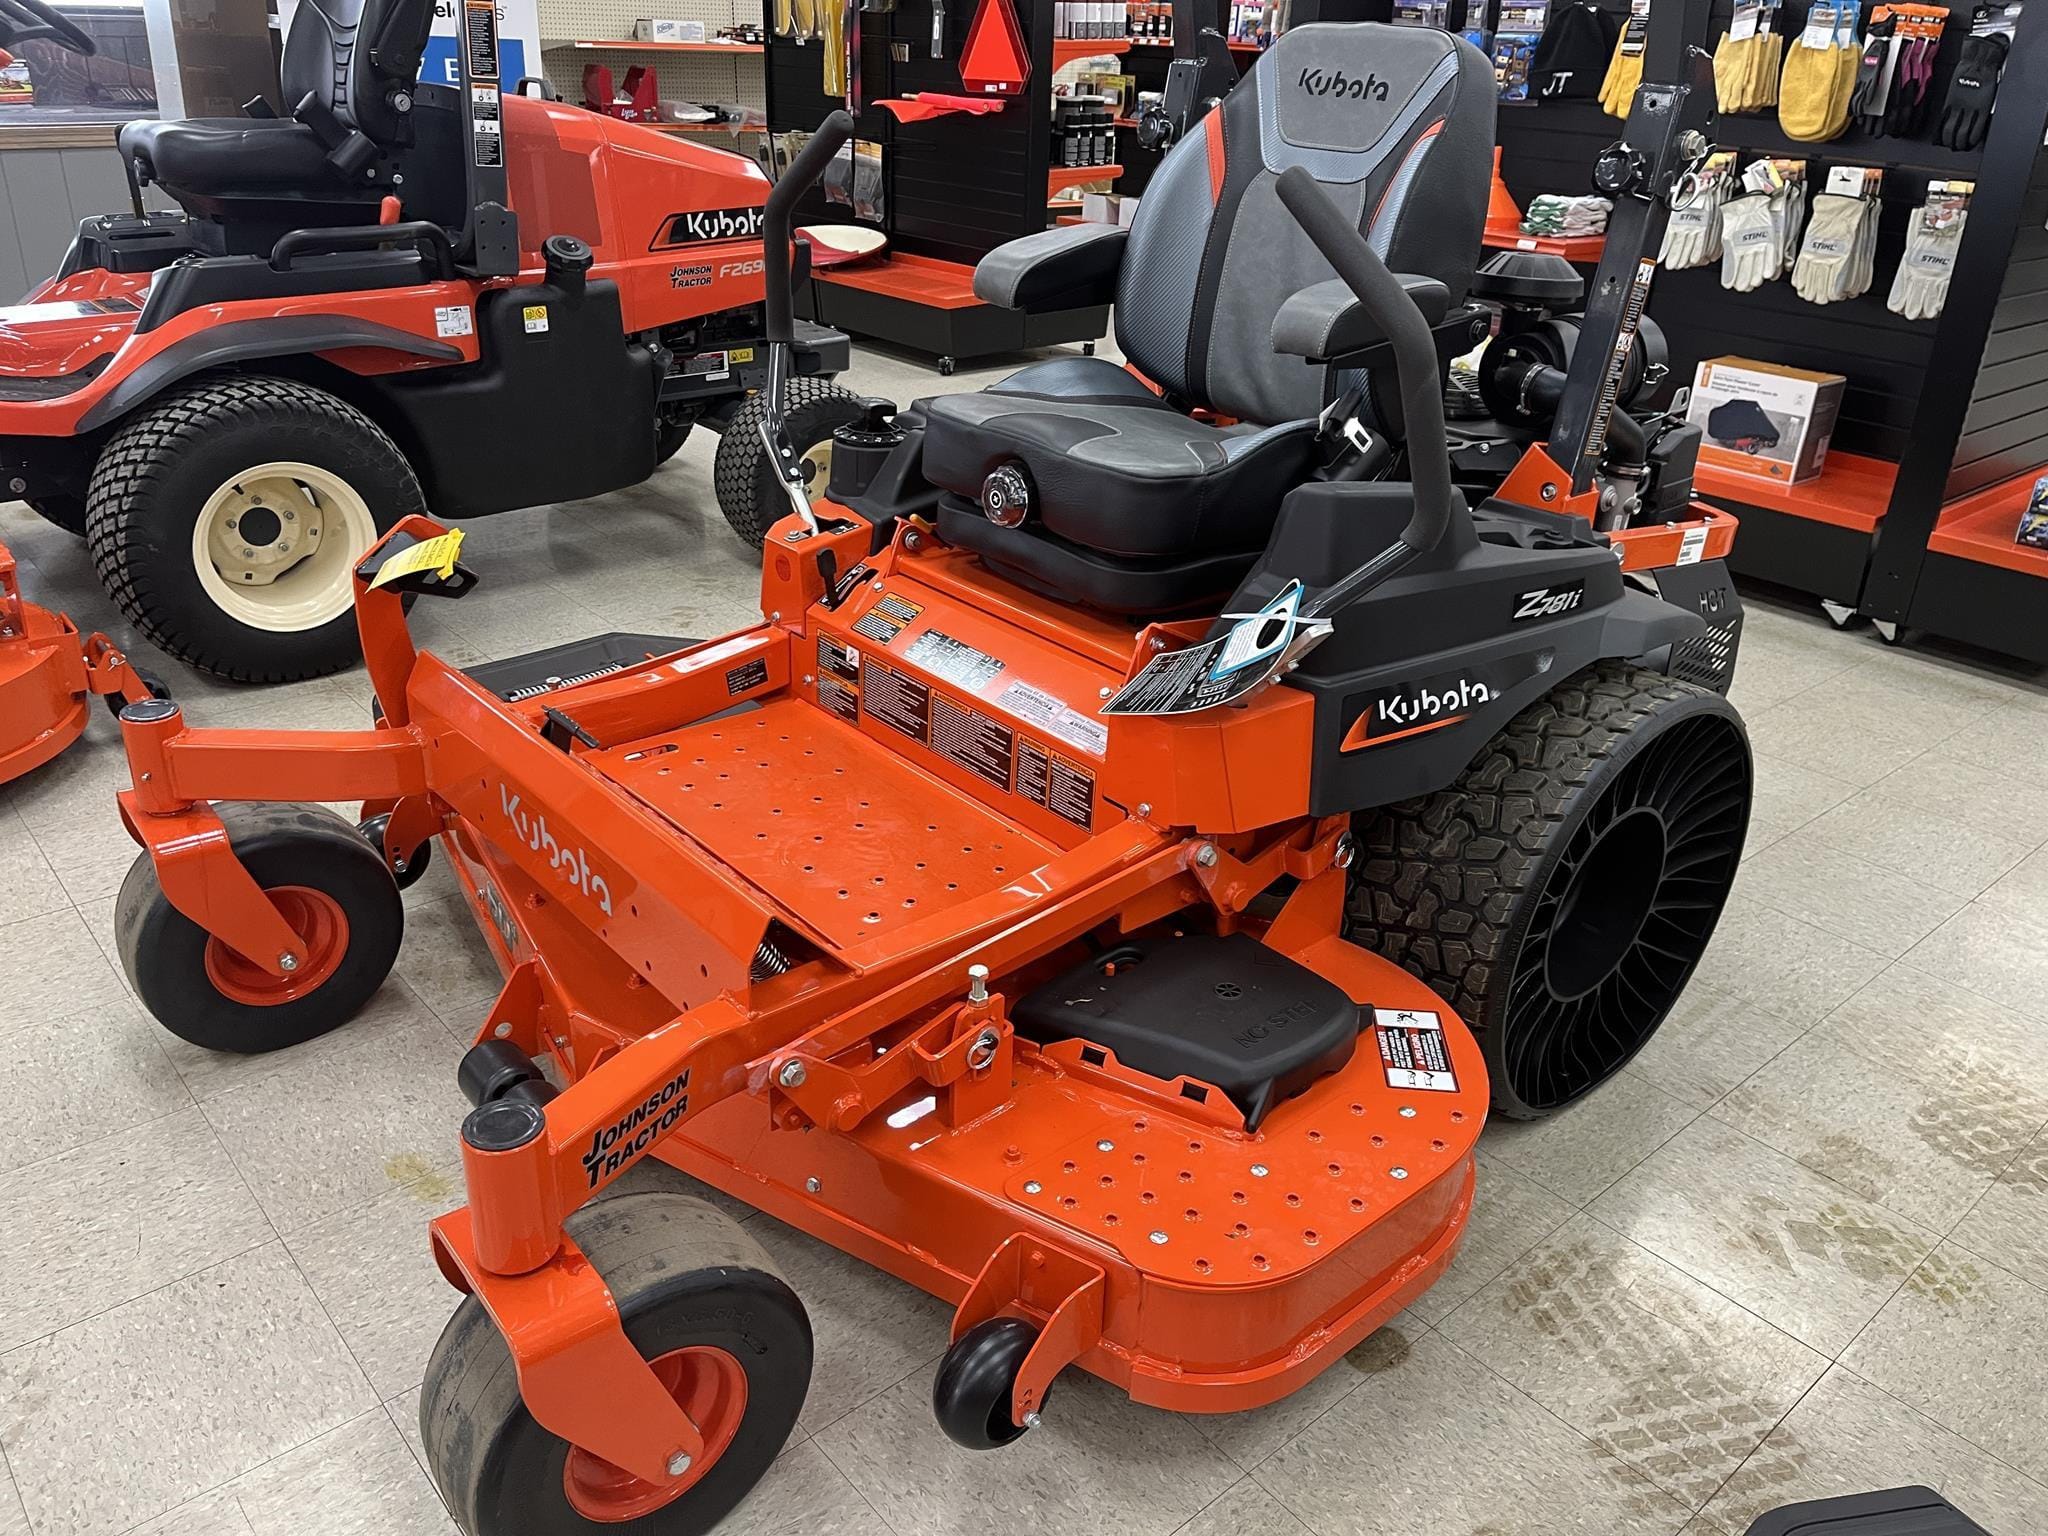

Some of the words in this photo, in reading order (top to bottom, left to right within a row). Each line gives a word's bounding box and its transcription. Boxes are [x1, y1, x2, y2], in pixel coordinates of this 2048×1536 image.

[1298, 68, 1389, 101] Kubota
[1543, 71, 1573, 95] JT
[1680, 214, 1703, 222] STIHL
[1742, 231, 1769, 241] STIHL
[1812, 241, 1836, 251] STIHL
[670, 265, 712, 278] JOHNSON
[720, 259, 766, 278] F269
[1921, 255, 1950, 265] STIHL
[671, 277, 712, 289] TRACTOR
[1513, 588, 1584, 618] Z781i
[1379, 678, 1490, 724] Kubota
[499, 781, 613, 917] Kubota
[1378, 1031, 1391, 1057] DANGER
[1410, 1034, 1425, 1060] PELIGRO
[582, 1068, 690, 1165] JOHNSON
[586, 1094, 688, 1189] TRACTOR
